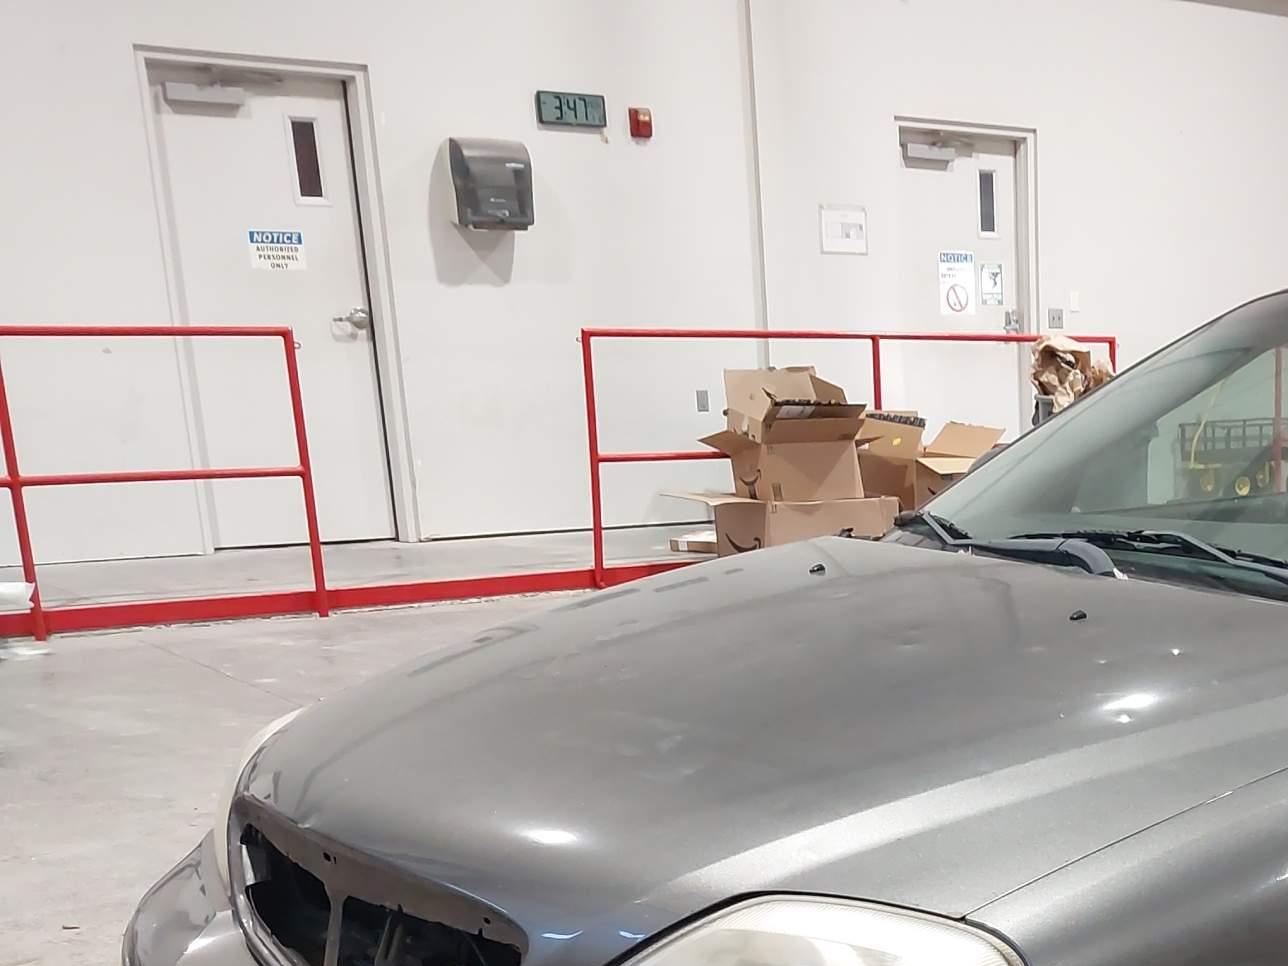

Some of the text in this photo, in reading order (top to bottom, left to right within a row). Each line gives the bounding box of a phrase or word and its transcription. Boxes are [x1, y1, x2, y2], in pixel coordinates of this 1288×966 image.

[253, 232, 300, 244] NOTICE
[256, 245, 299, 253] AUTHORIZED
[940, 252, 973, 263] NOTICE
